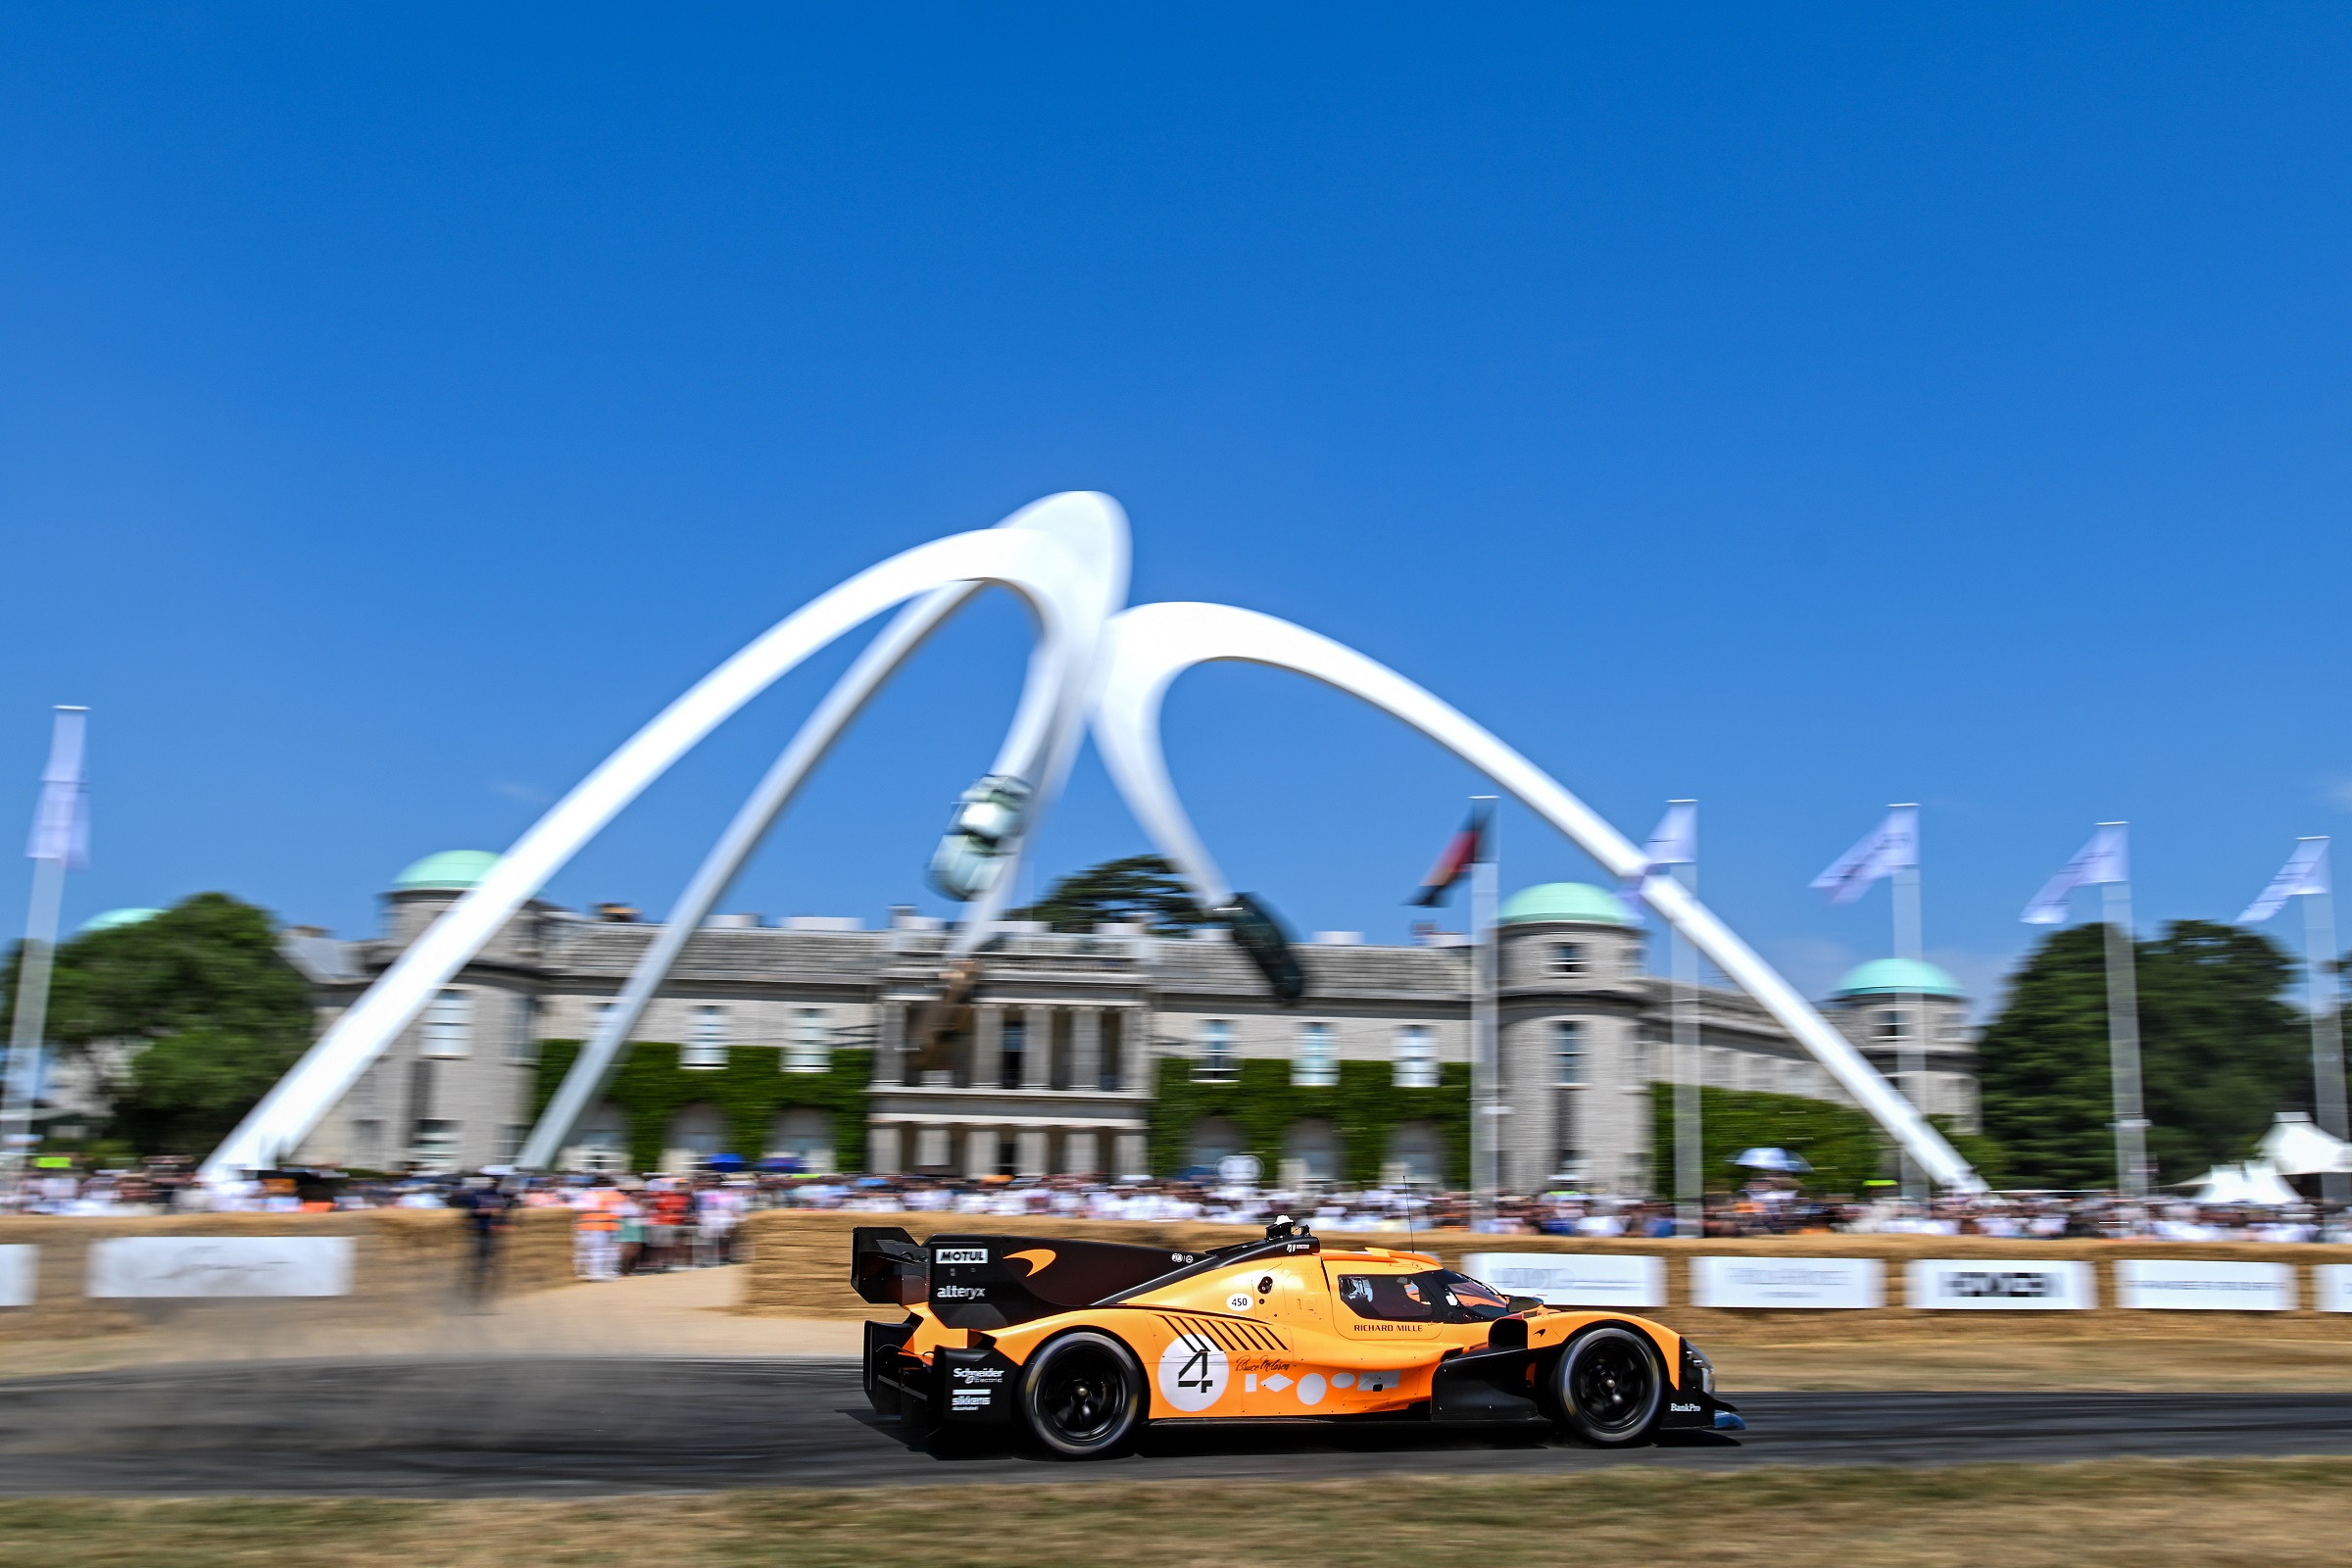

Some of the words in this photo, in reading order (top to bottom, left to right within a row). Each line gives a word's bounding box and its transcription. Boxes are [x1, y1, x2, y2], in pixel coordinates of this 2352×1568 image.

[941, 1250, 985, 1261] MOTUL
[937, 1285, 986, 1299] alteryx
[1231, 1298, 1248, 1307] 450
[1236, 1354, 1260, 1372] Bruce
[953, 1367, 1004, 1378] Schneider
[1178, 1348, 1213, 1394] 4
[952, 1396, 991, 1405] sikkens
[1670, 1402, 1701, 1412] BankPro
